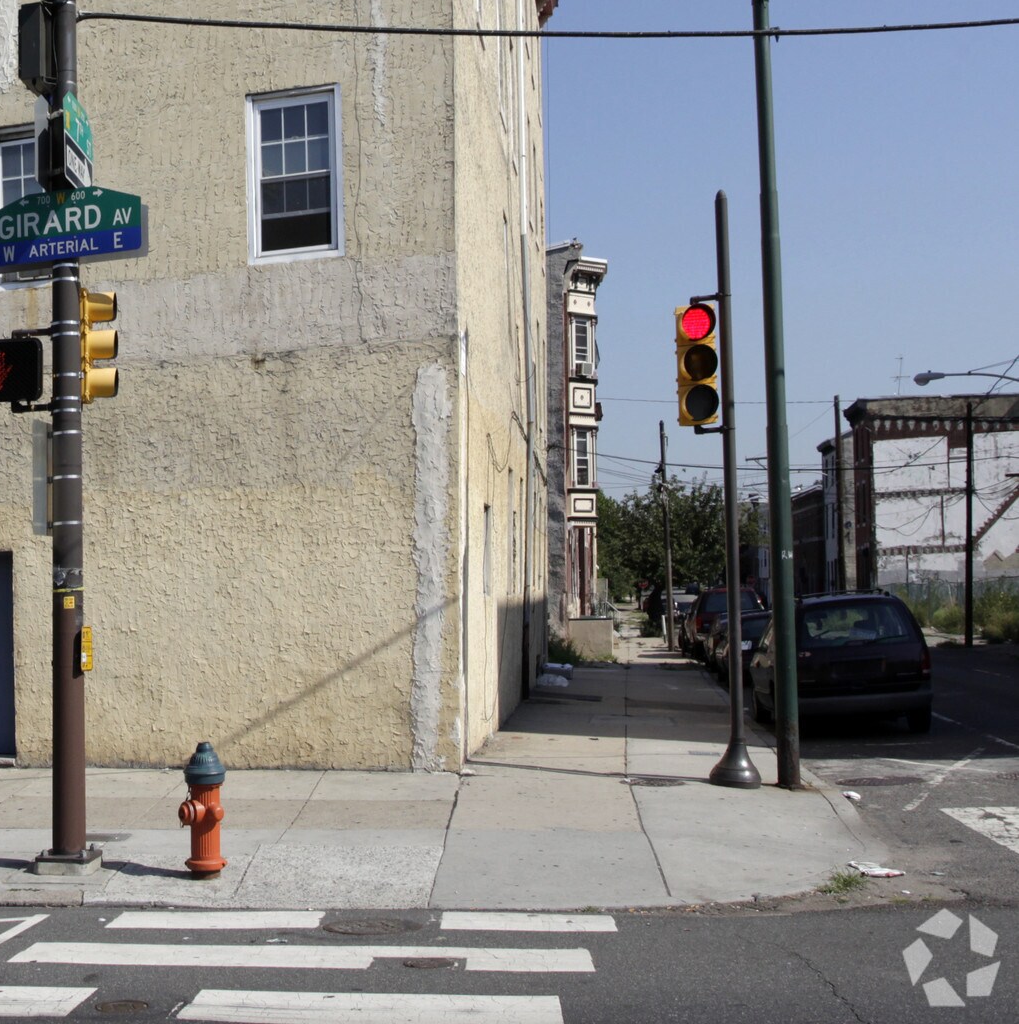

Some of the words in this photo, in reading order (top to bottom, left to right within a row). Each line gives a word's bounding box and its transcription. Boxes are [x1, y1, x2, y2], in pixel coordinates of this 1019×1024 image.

[37, 195, 51, 205] 700
[56, 192, 66, 204] W
[70, 190, 86, 201] 600
[112, 206, 132, 226] AV
[3, 245, 15, 262] W
[29, 237, 99, 258] ARTERIAL
[113, 231, 123, 249] E
